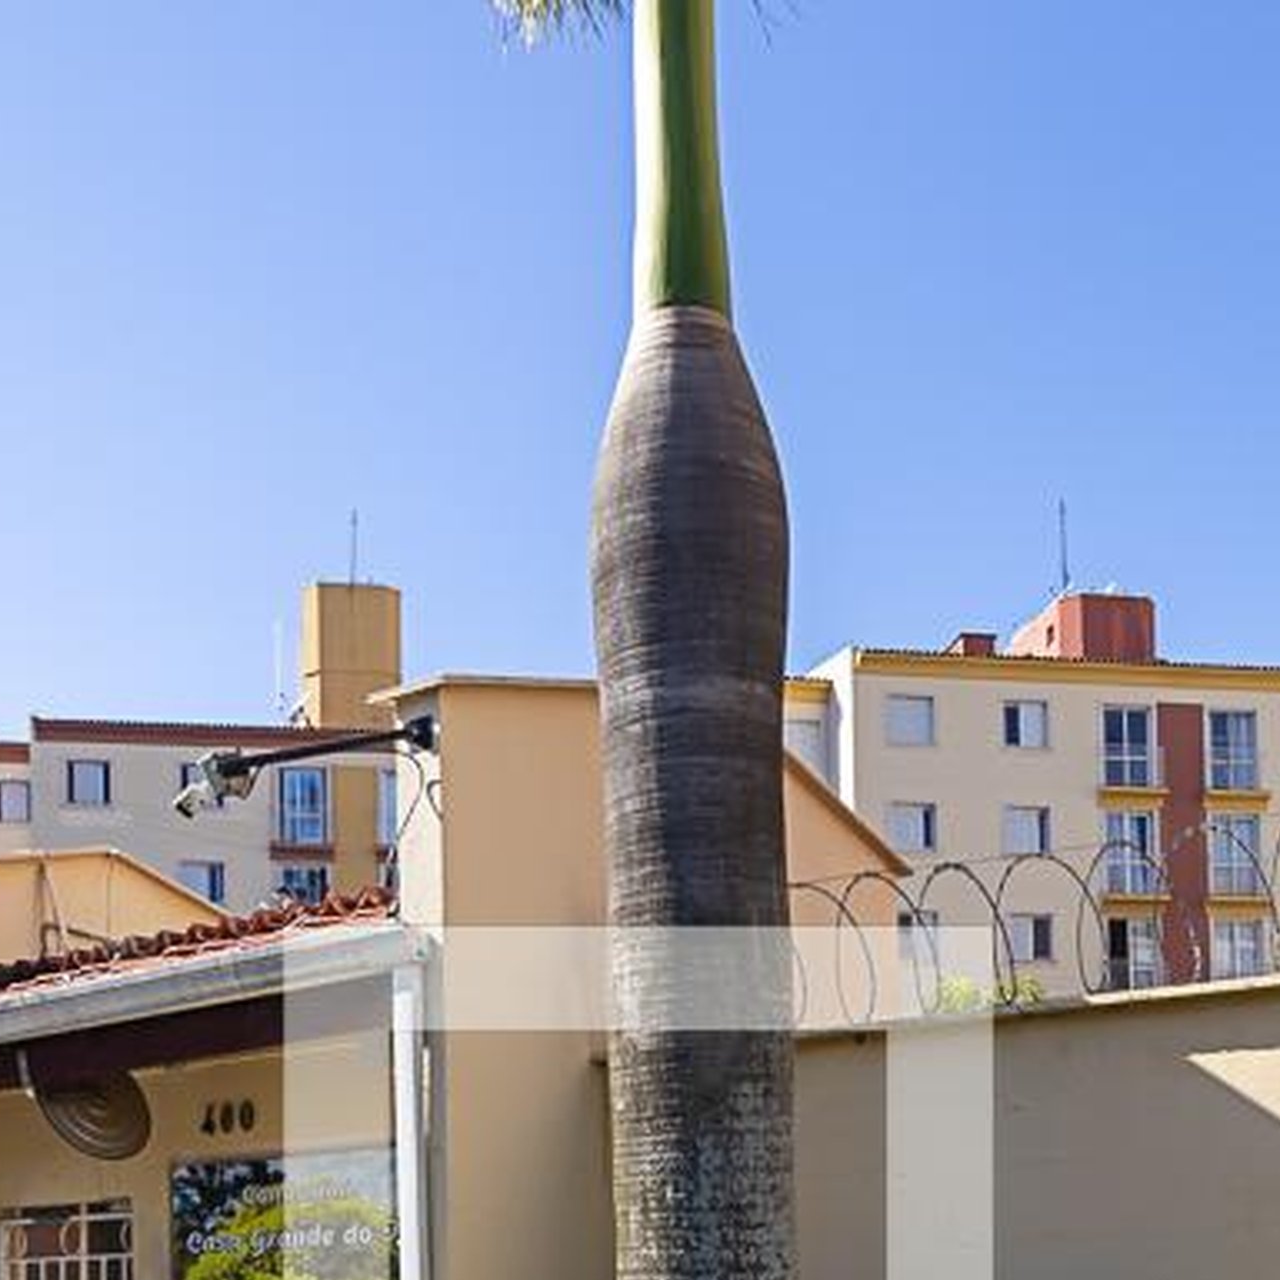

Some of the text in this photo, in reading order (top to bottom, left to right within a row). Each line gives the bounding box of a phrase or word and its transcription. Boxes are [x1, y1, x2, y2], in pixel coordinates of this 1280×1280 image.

[200, 1098, 255, 1137] 400
[250, 1223, 336, 1255] Grande
[342, 1224, 373, 1245] do
